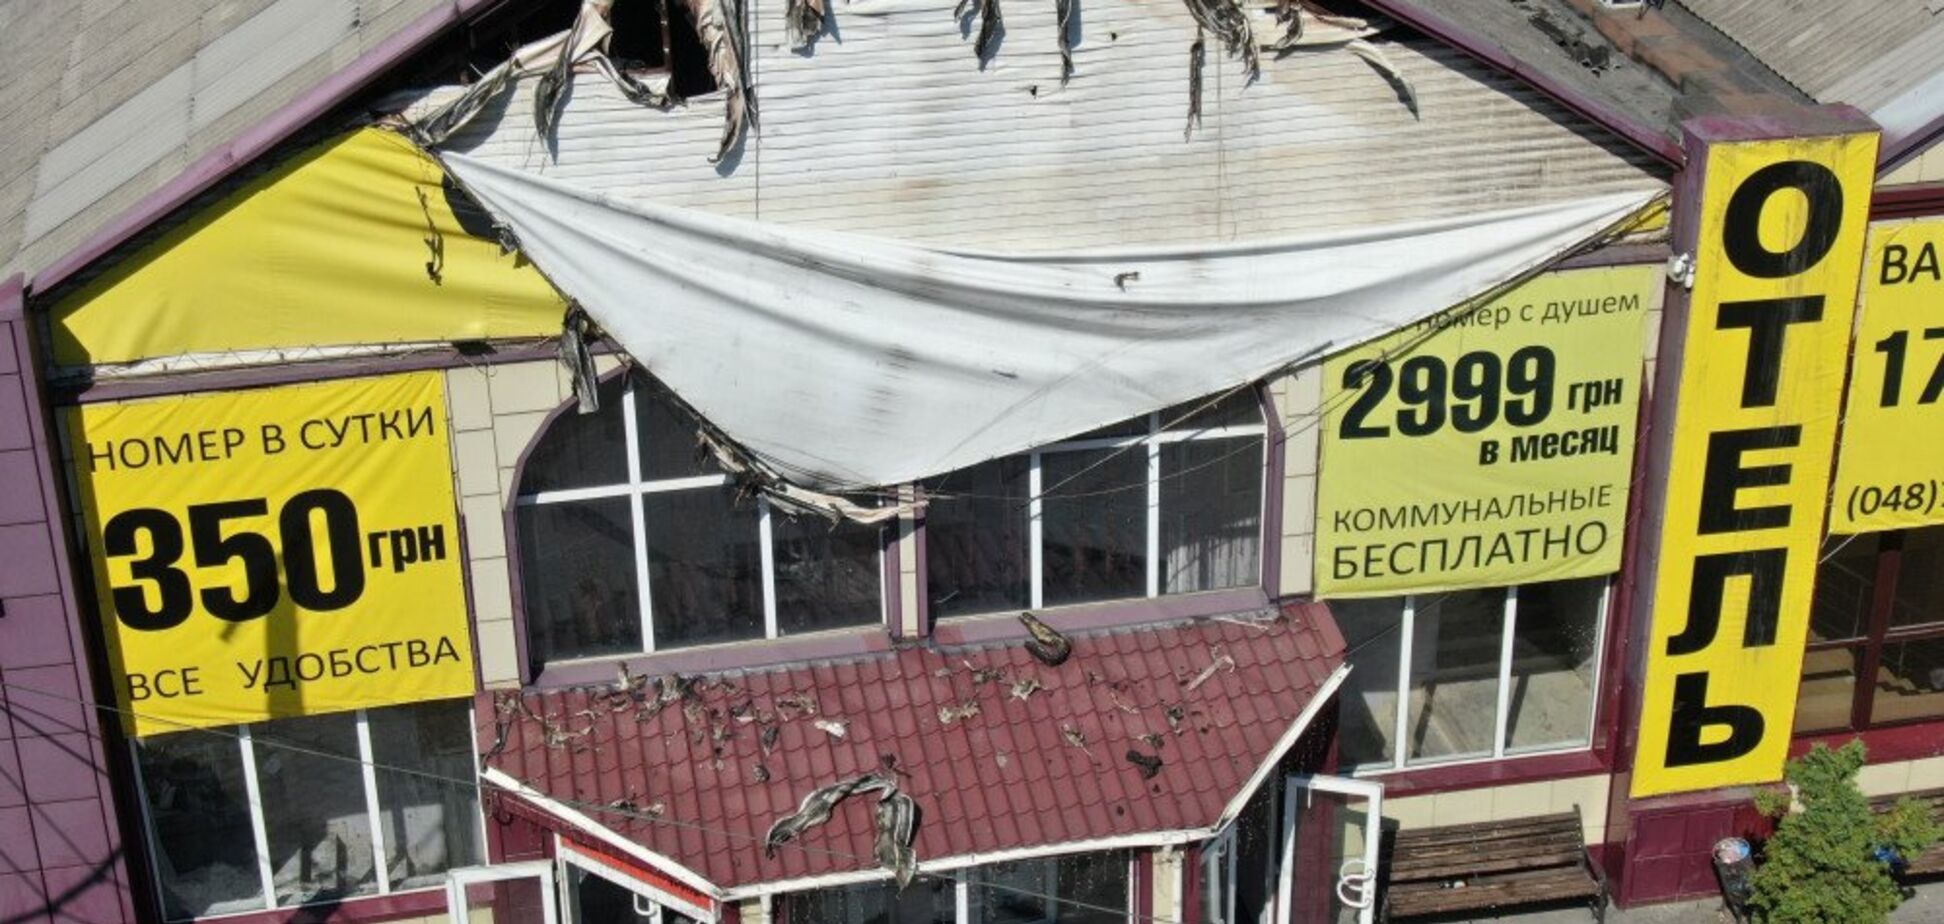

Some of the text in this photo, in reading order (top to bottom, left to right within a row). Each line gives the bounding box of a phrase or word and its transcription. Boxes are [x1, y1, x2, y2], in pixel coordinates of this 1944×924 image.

[1519, 303, 1533, 323] с
[1541, 293, 1640, 324] душем
[1339, 345, 1623, 440] 2999 грн
[88, 405, 435, 473] НОМЕР В СУТКИ
[1479, 424, 1620, 466] в месяц
[1664, 159, 1844, 768] ОТЕЛЬ
[1333, 483, 1613, 533] КОММУНАЛЬНЫЕ
[1847, 479, 1944, 522] (048)
[103, 488, 446, 632] 350 грн
[1332, 520, 1608, 580] БЕСПЛАТНО
[127, 635, 461, 701] ВСЕ УДОБСТВА
